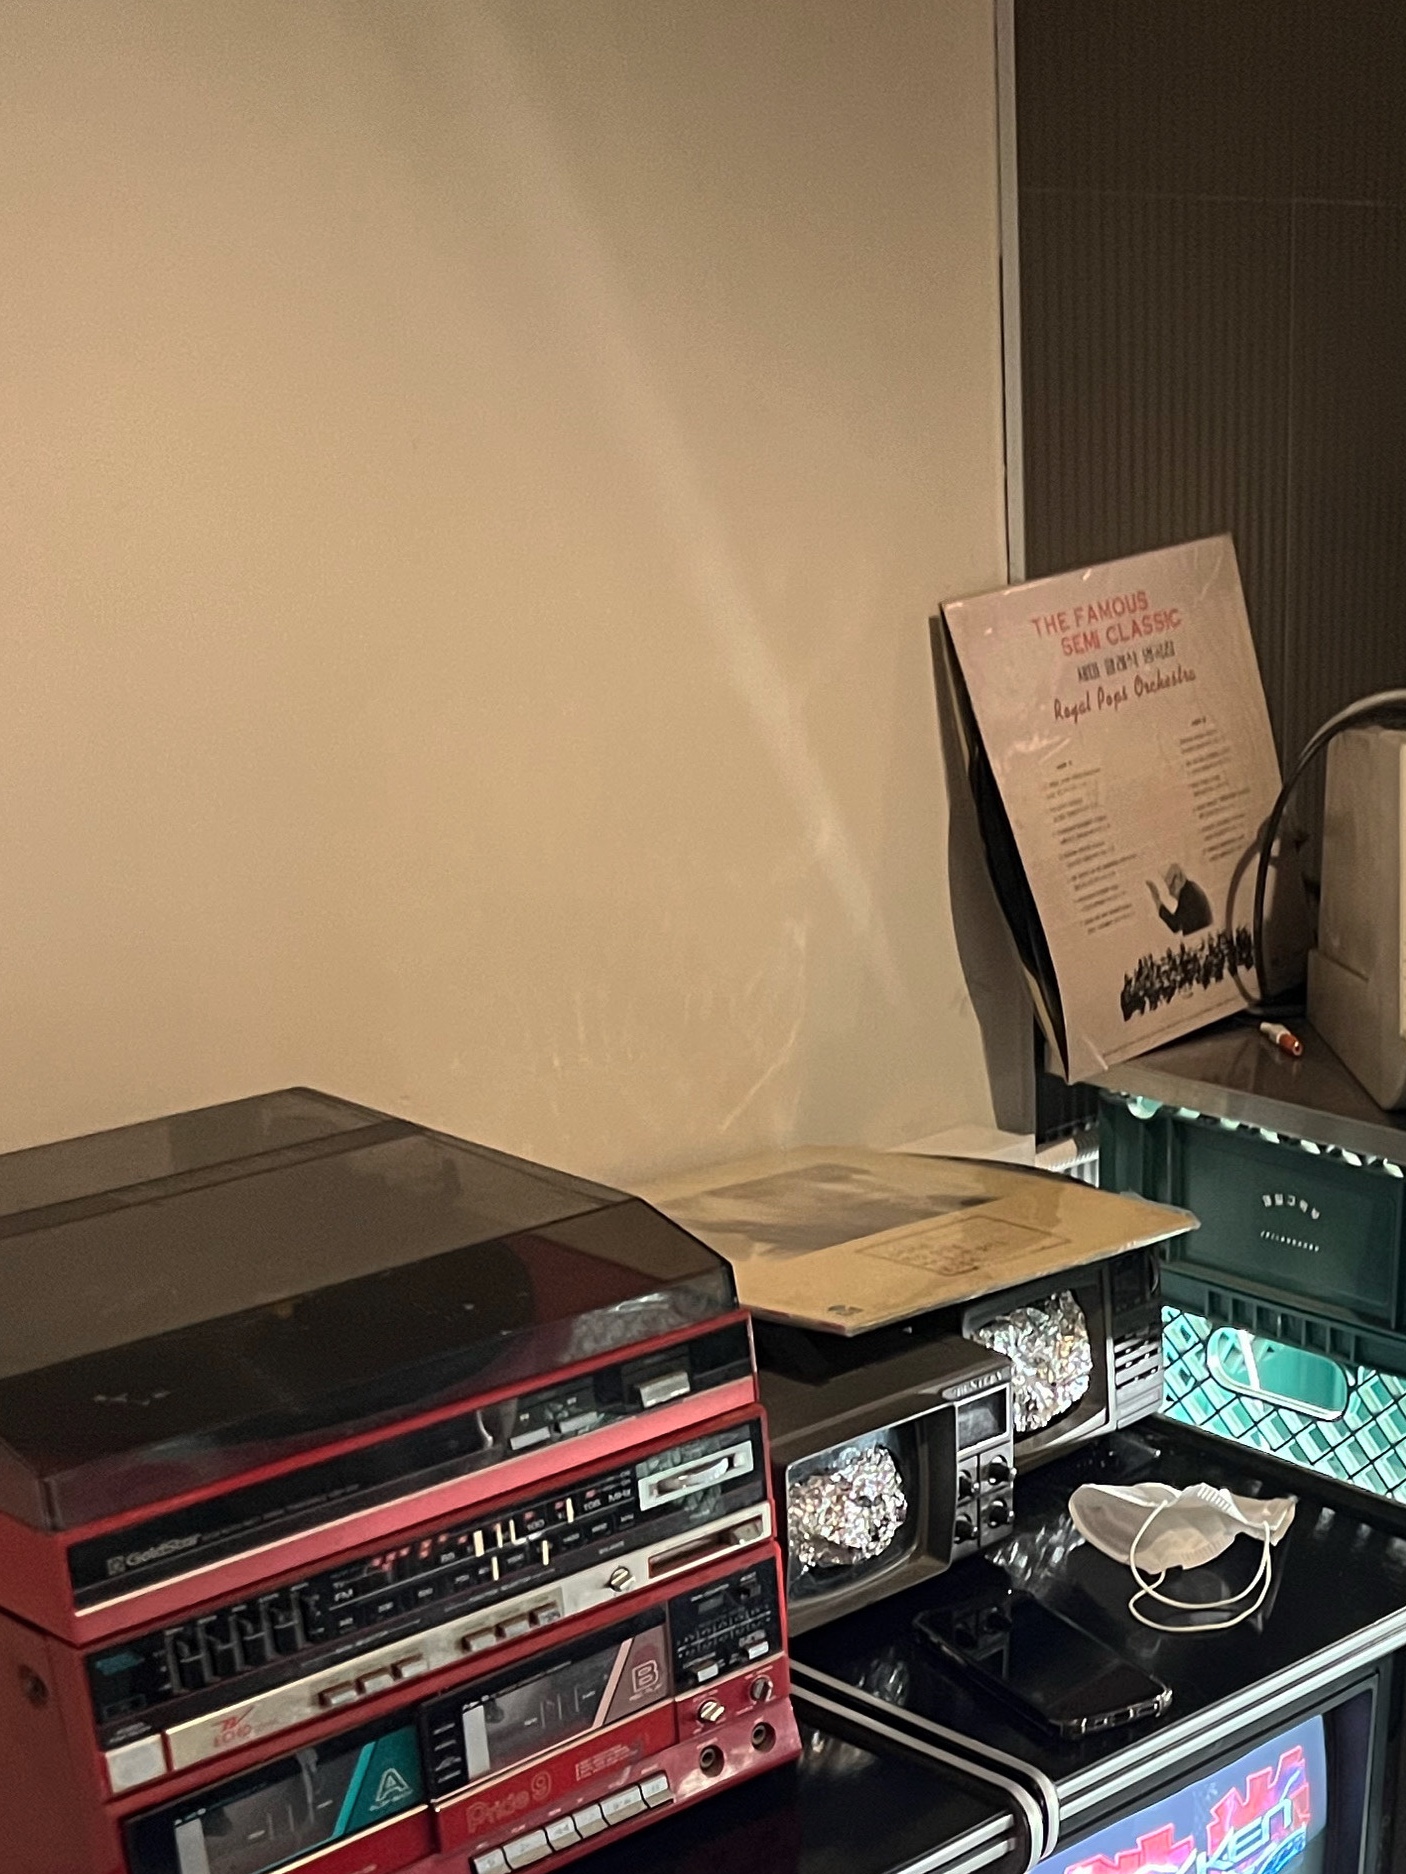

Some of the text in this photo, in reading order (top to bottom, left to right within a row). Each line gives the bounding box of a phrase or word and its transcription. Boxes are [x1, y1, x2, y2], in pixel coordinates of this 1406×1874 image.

[1032, 591, 1149, 637] THE FAMOUS
[1061, 608, 1182, 656] SEMI CLASSIC
[1054, 664, 1196, 724] Royal Pops Orchestra
